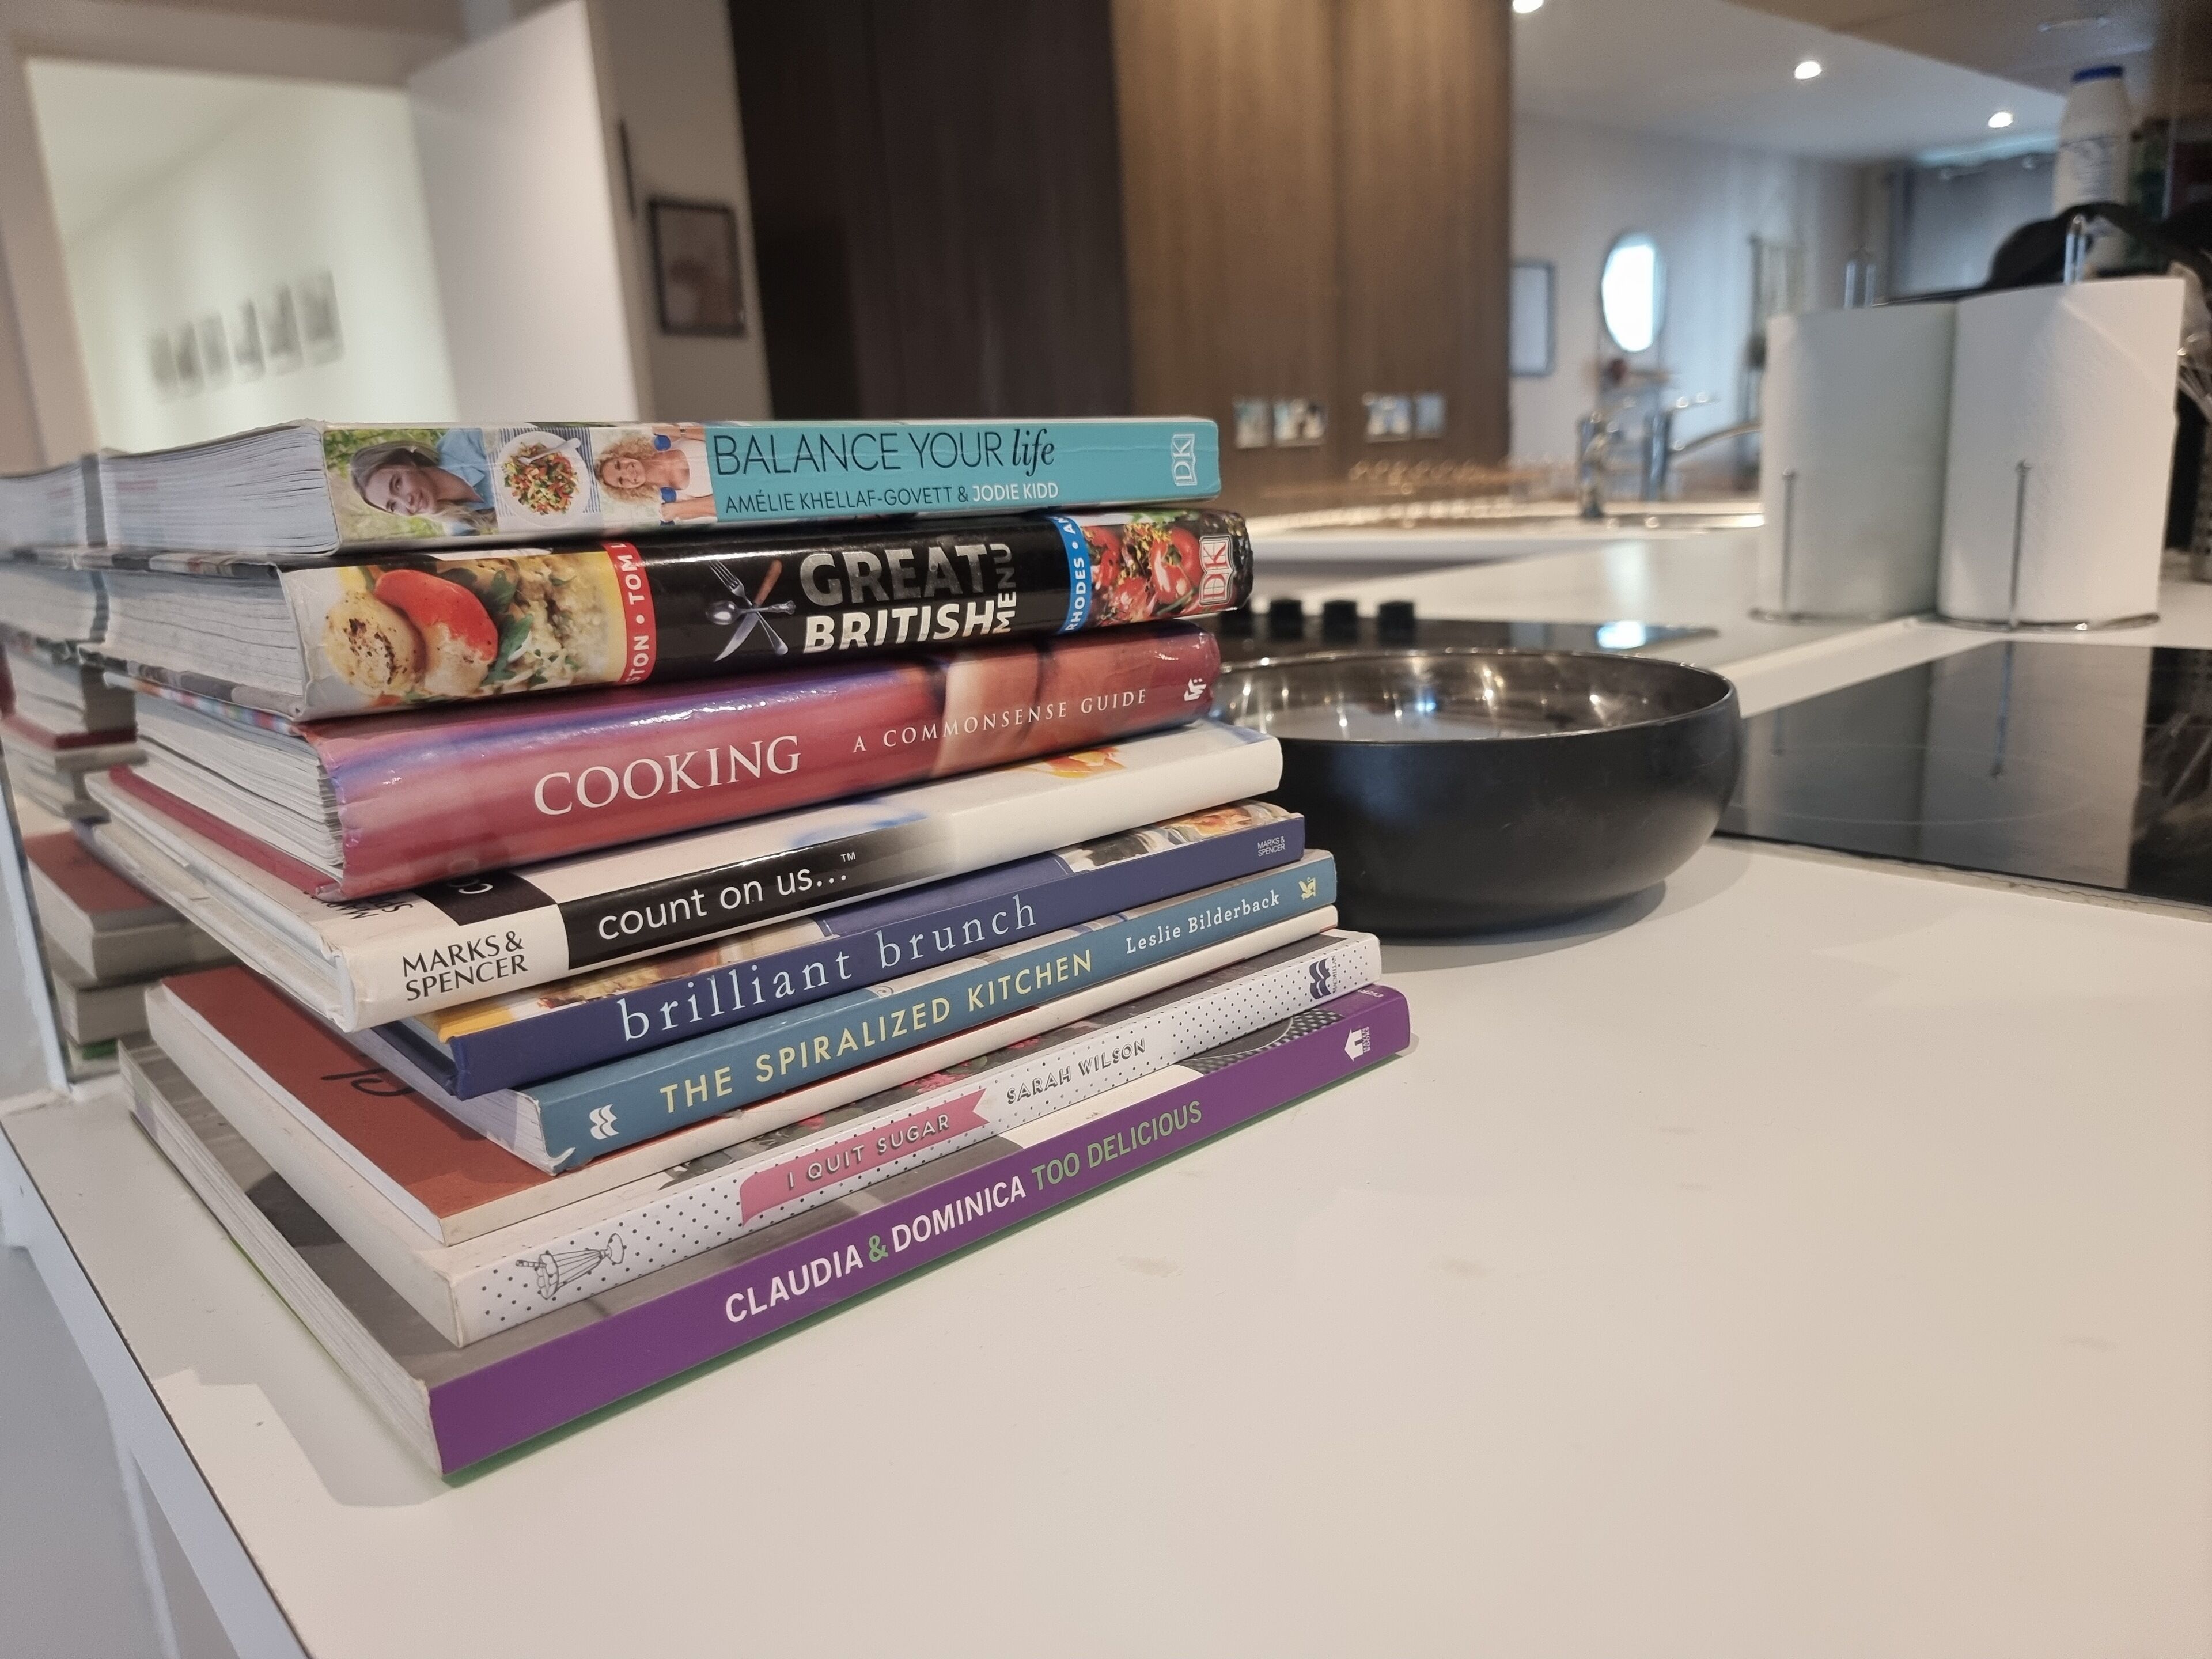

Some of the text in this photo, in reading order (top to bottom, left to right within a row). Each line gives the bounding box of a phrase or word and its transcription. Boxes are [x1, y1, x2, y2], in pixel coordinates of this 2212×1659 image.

[714, 429, 1055, 476] BALANCE YOUR life
[1172, 435, 1196, 484] DK
[726, 482, 1059, 514] AMÉLIE KHELLAF-GOVETT & JODIE KIDD
[617, 555, 645, 605] TOM
[800, 544, 987, 606] GREAT
[990, 543, 1017, 634] MENU
[1065, 557, 1086, 631] RHODES
[1202, 538, 1229, 603] DK
[803, 600, 995, 654] BRITISH
[534, 688, 1147, 815] COOKING A COMMONSENSE GUIDE
[1257, 837, 1280, 850] MARKS
[1257, 843, 1286, 857] SPENCER
[599, 889, 707, 940] count
[720, 880, 763, 910] on
[403, 931, 525, 978] MARKS &
[406, 954, 529, 1001] SPENCER
[617, 894, 1036, 1041] brilliant brunch
[660, 889, 1279, 1113] THE SPIRALIZED KITCHEN Leslie Bilderback
[788, 1037, 1146, 1188] I QUIT SUGAR SARAH WILSON
[725, 1100, 1202, 1324] CLAUDIA & DOMINICA TOO DELICIOUS
